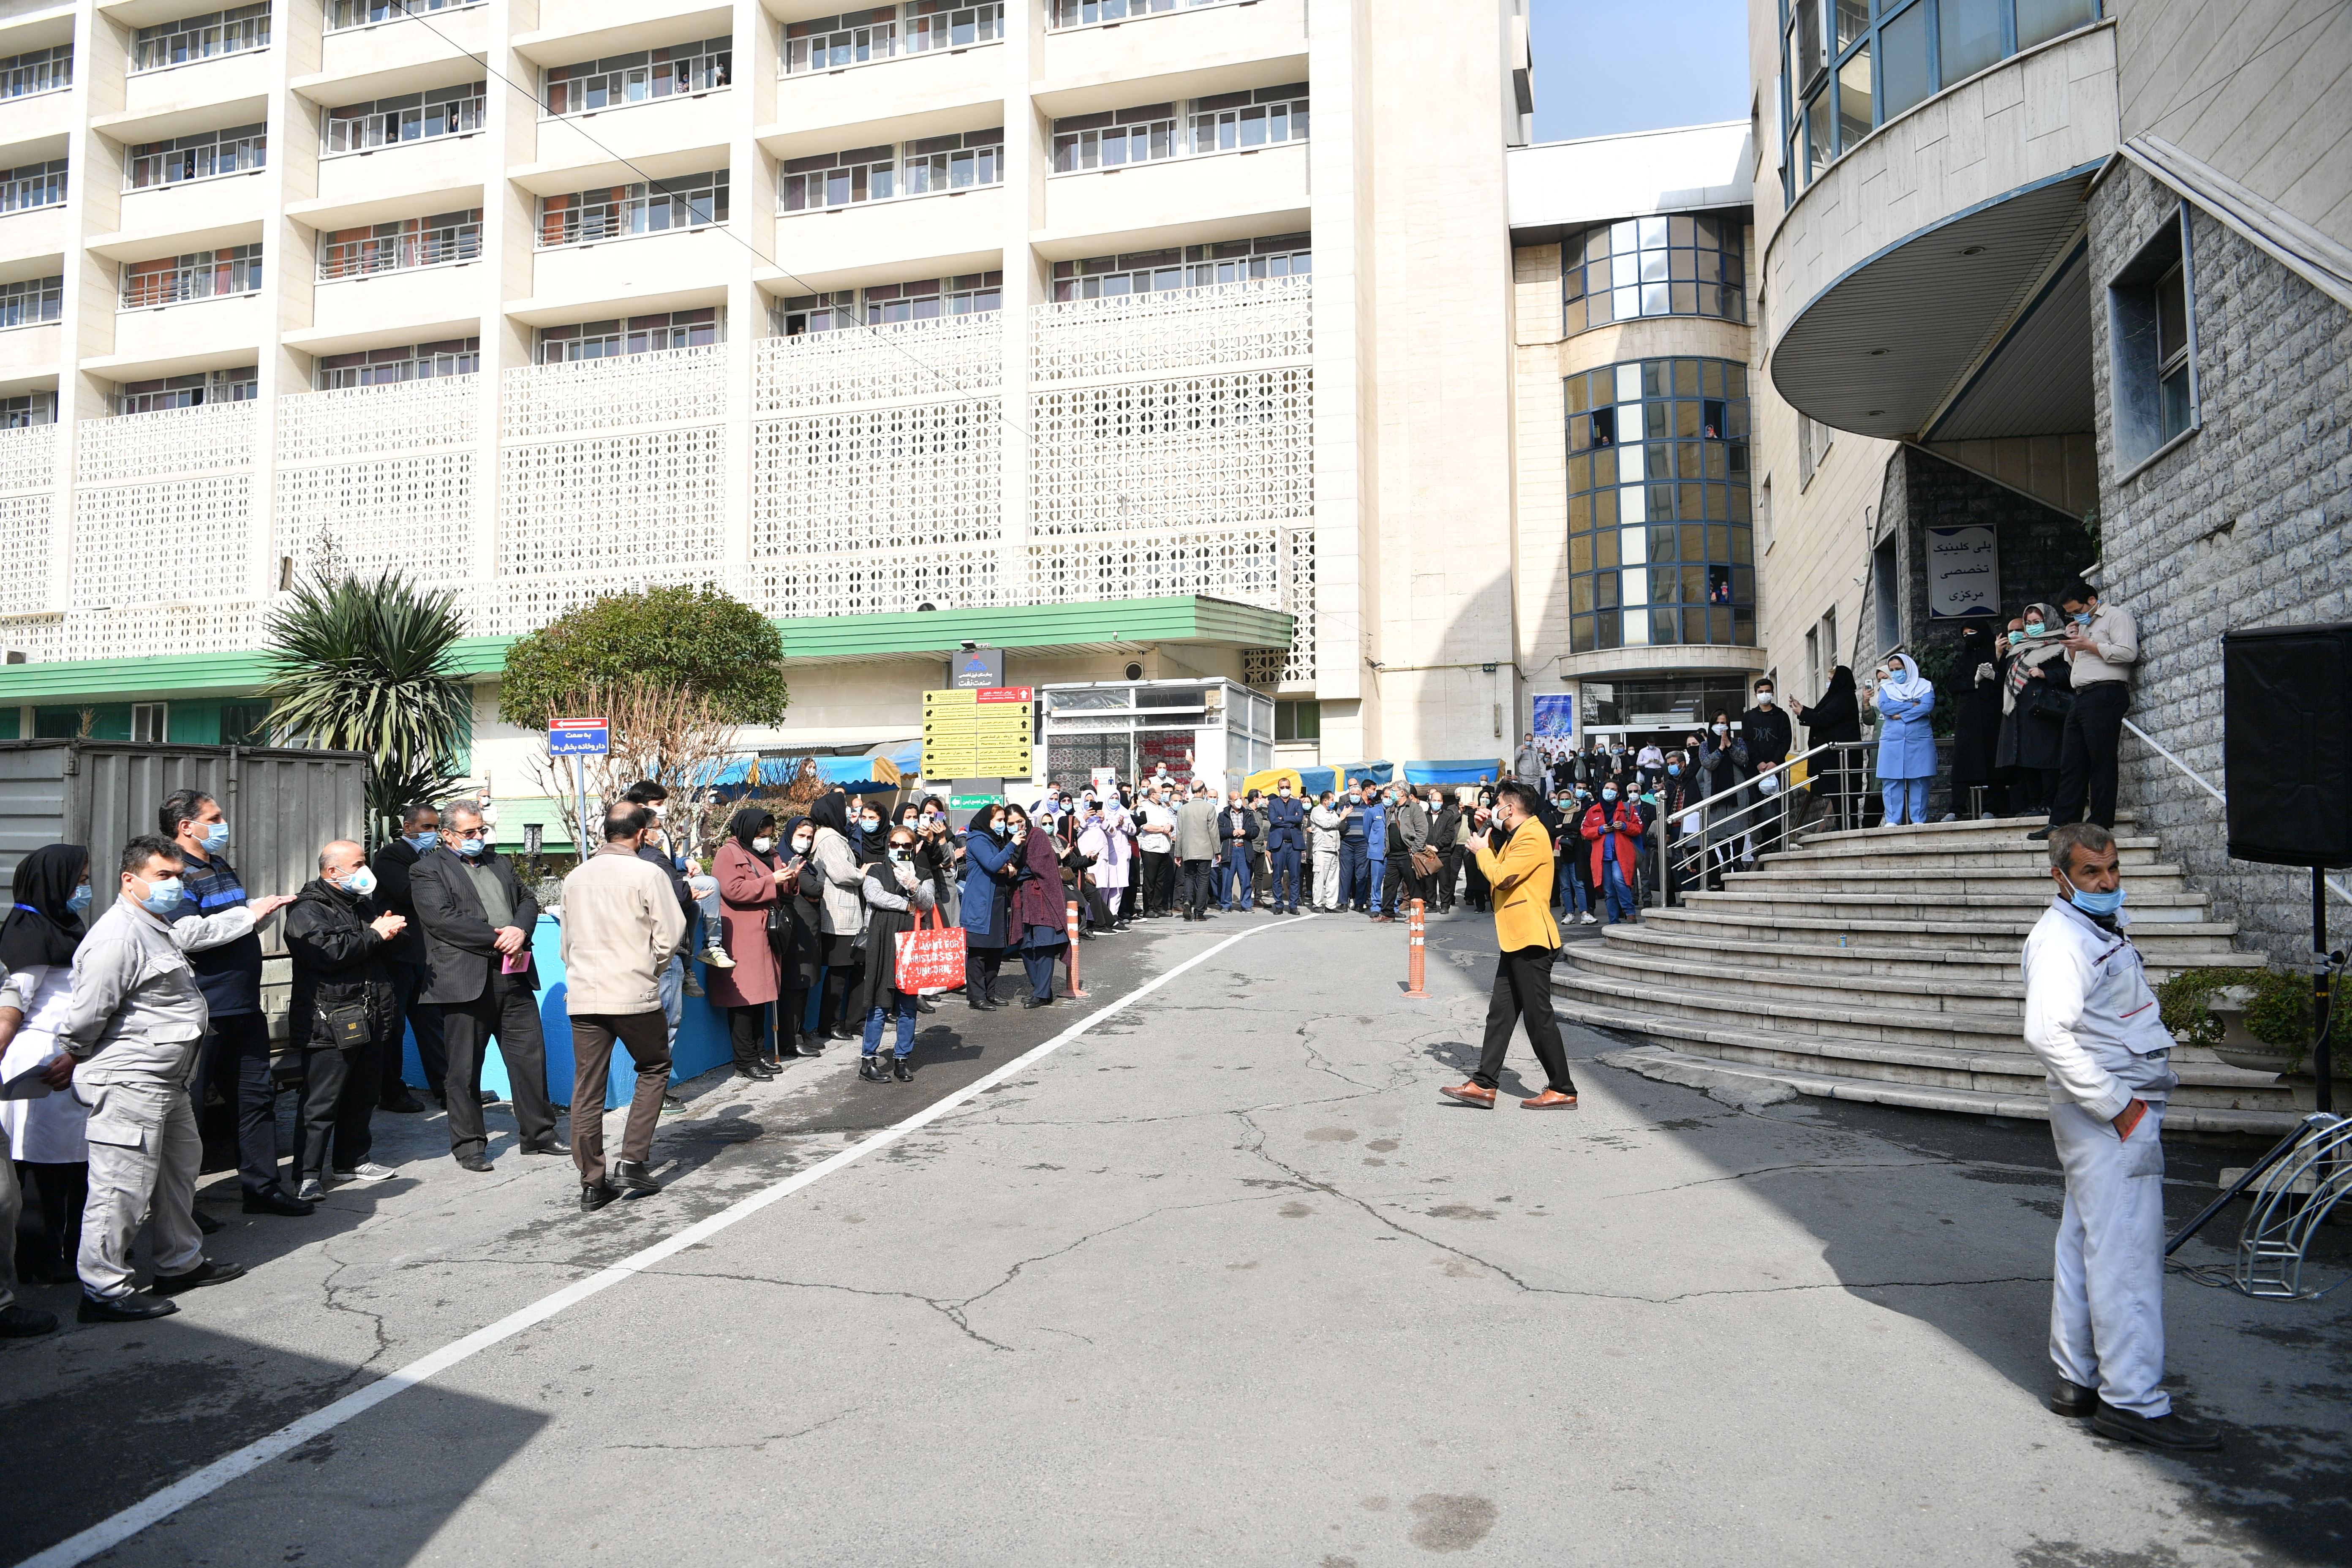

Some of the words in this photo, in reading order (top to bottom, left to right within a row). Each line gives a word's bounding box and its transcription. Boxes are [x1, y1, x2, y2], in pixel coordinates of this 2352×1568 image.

[1933, 542, 1969, 555] کلینیک
[1974, 541, 1991, 553] پلی
[1940, 564, 1989, 579] تخصصی
[1949, 590, 1984, 602] مرکزی
[958, 678, 973, 686] نفت
[1753, 727, 1778, 741] DIOR
[560, 743, 577, 751] بخش
[578, 743, 605, 751] داروخانه
[945, 940, 959, 949] FOR
[906, 953, 944, 963] HRISTMAS
